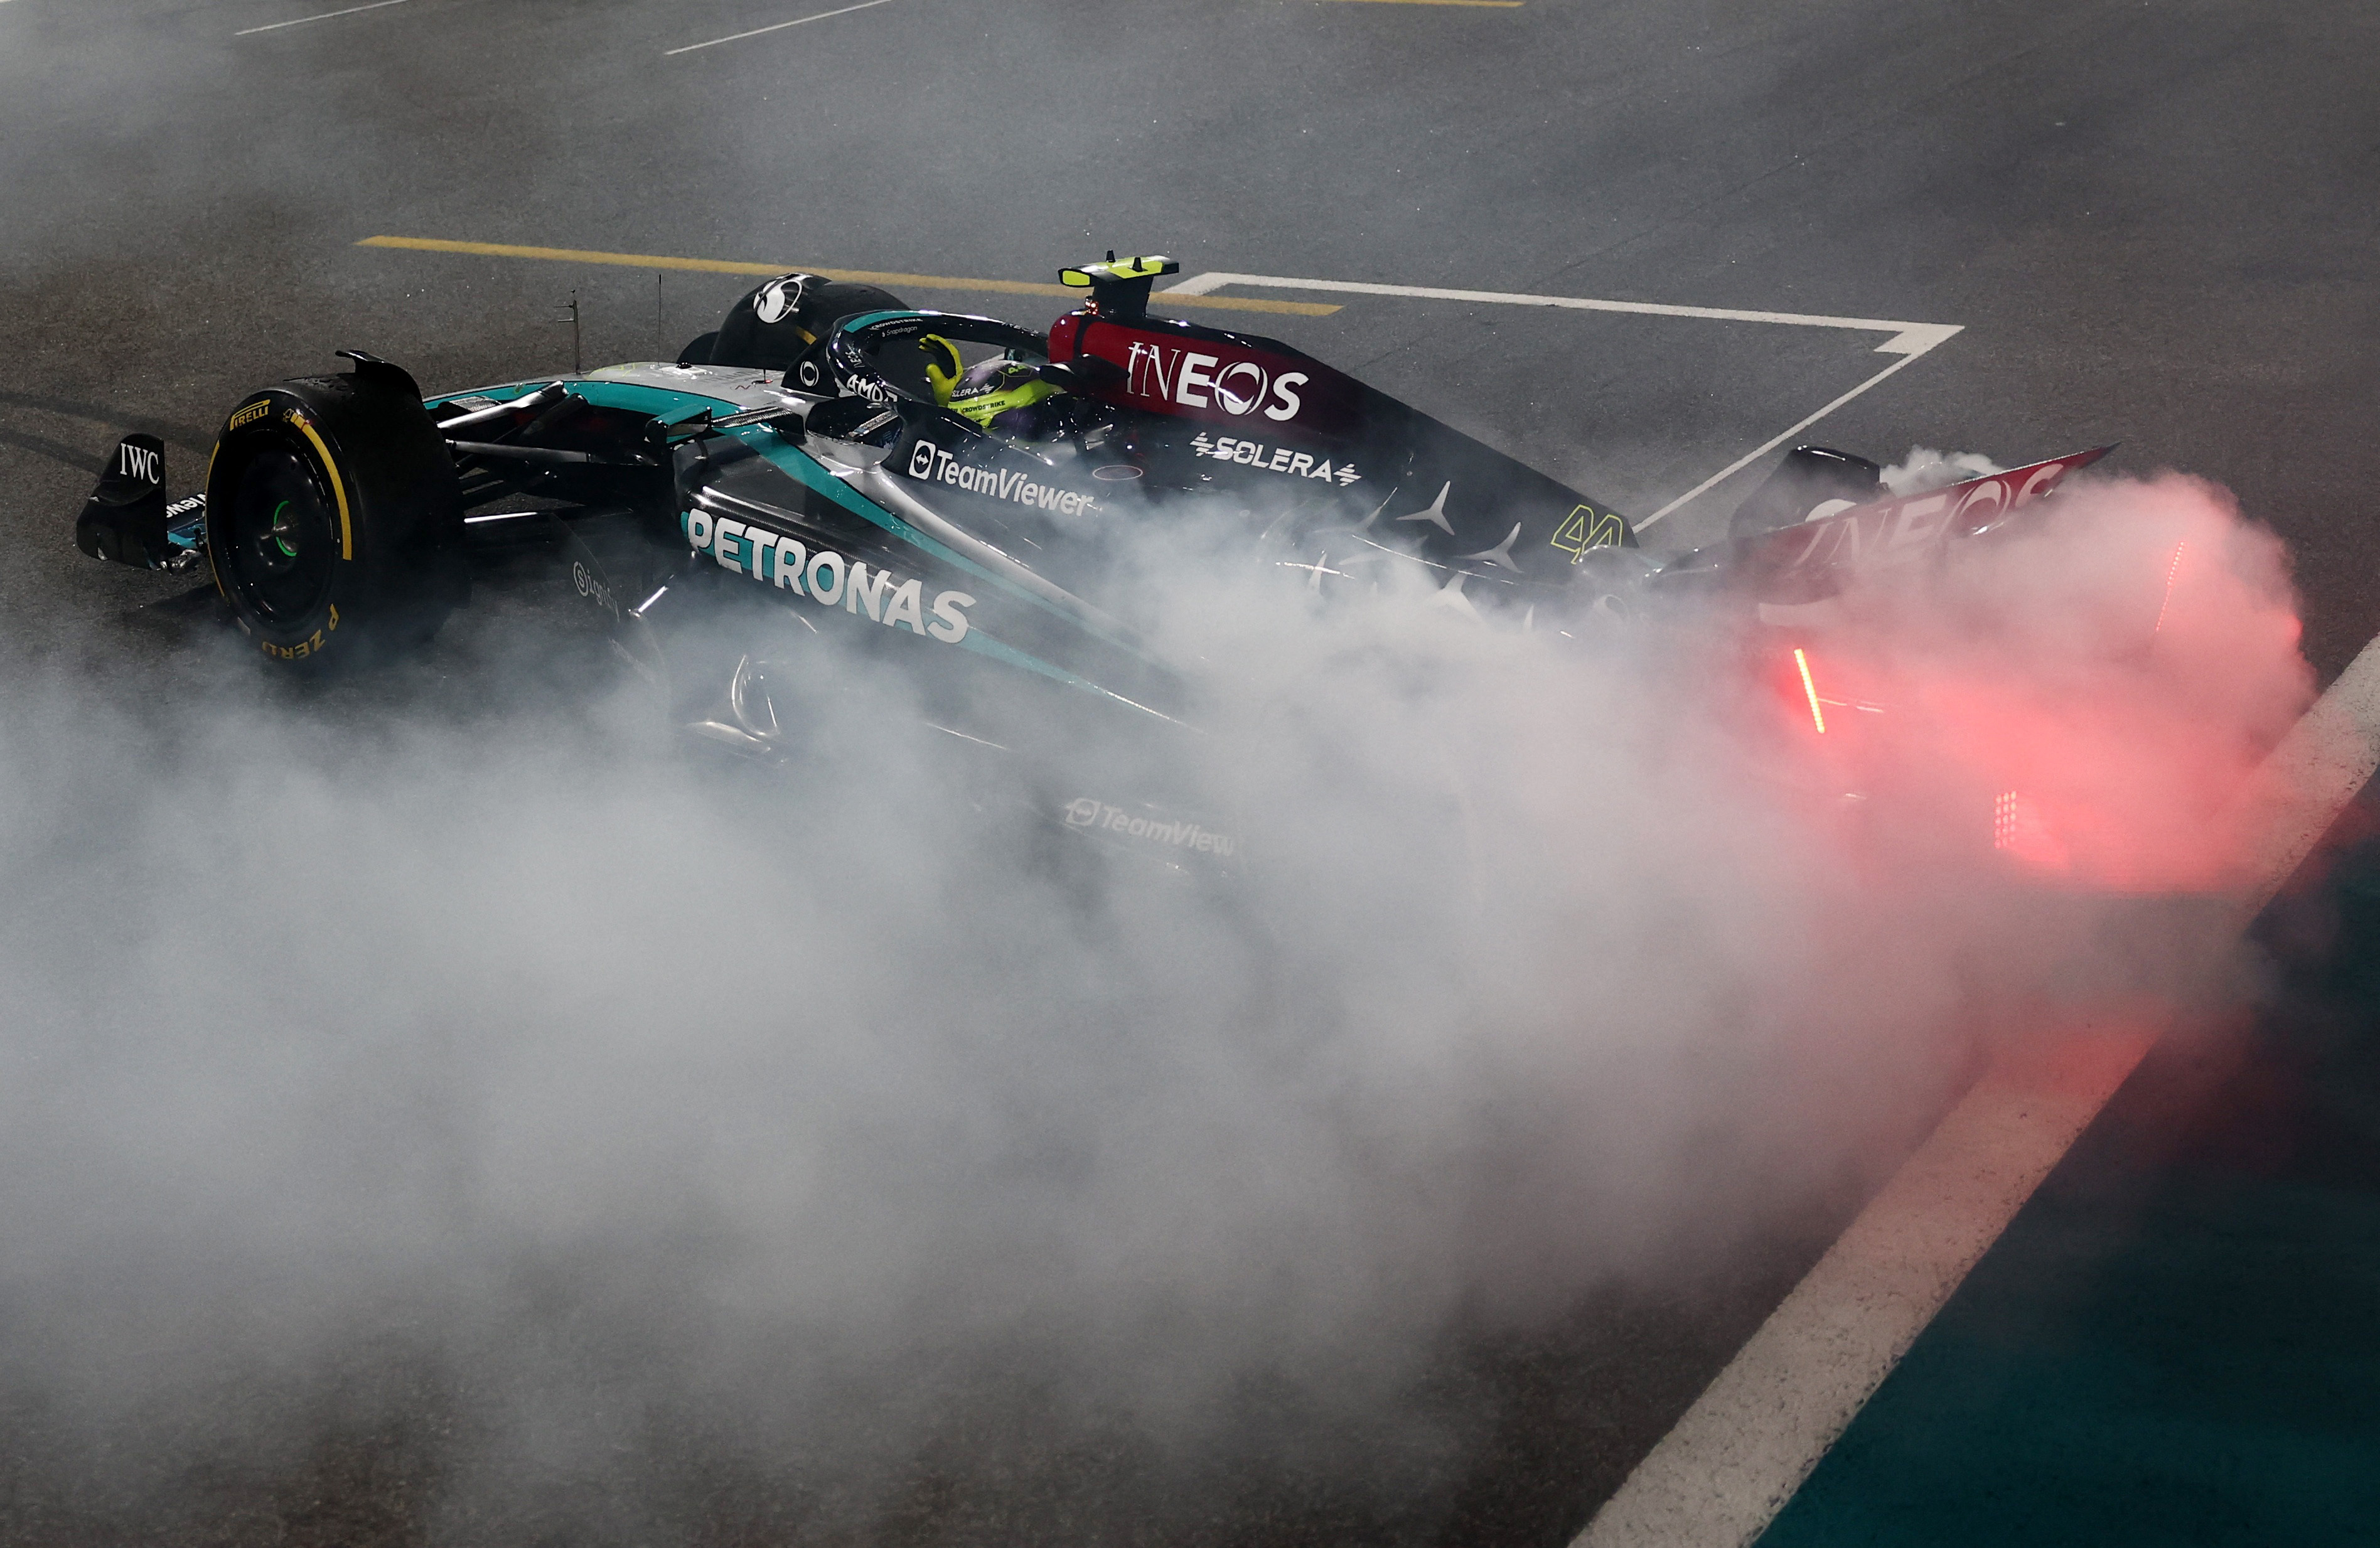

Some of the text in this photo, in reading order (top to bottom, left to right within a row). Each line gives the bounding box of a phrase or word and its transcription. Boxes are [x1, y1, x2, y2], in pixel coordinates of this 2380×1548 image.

[886, 326, 918, 336] Snapdragon
[846, 373, 884, 402] AMD
[1126, 341, 1310, 421] INEOS
[230, 399, 271, 432] PIRELLI
[962, 400, 1006, 413] CROWDSTRIKE
[119, 442, 159, 485] IWC
[1211, 437, 1332, 483] SOLERA
[936, 449, 1094, 516] TeamViewer
[1550, 504, 1623, 565] 44
[687, 508, 977, 644] PETRONAS
[329, 603, 340, 631] P
